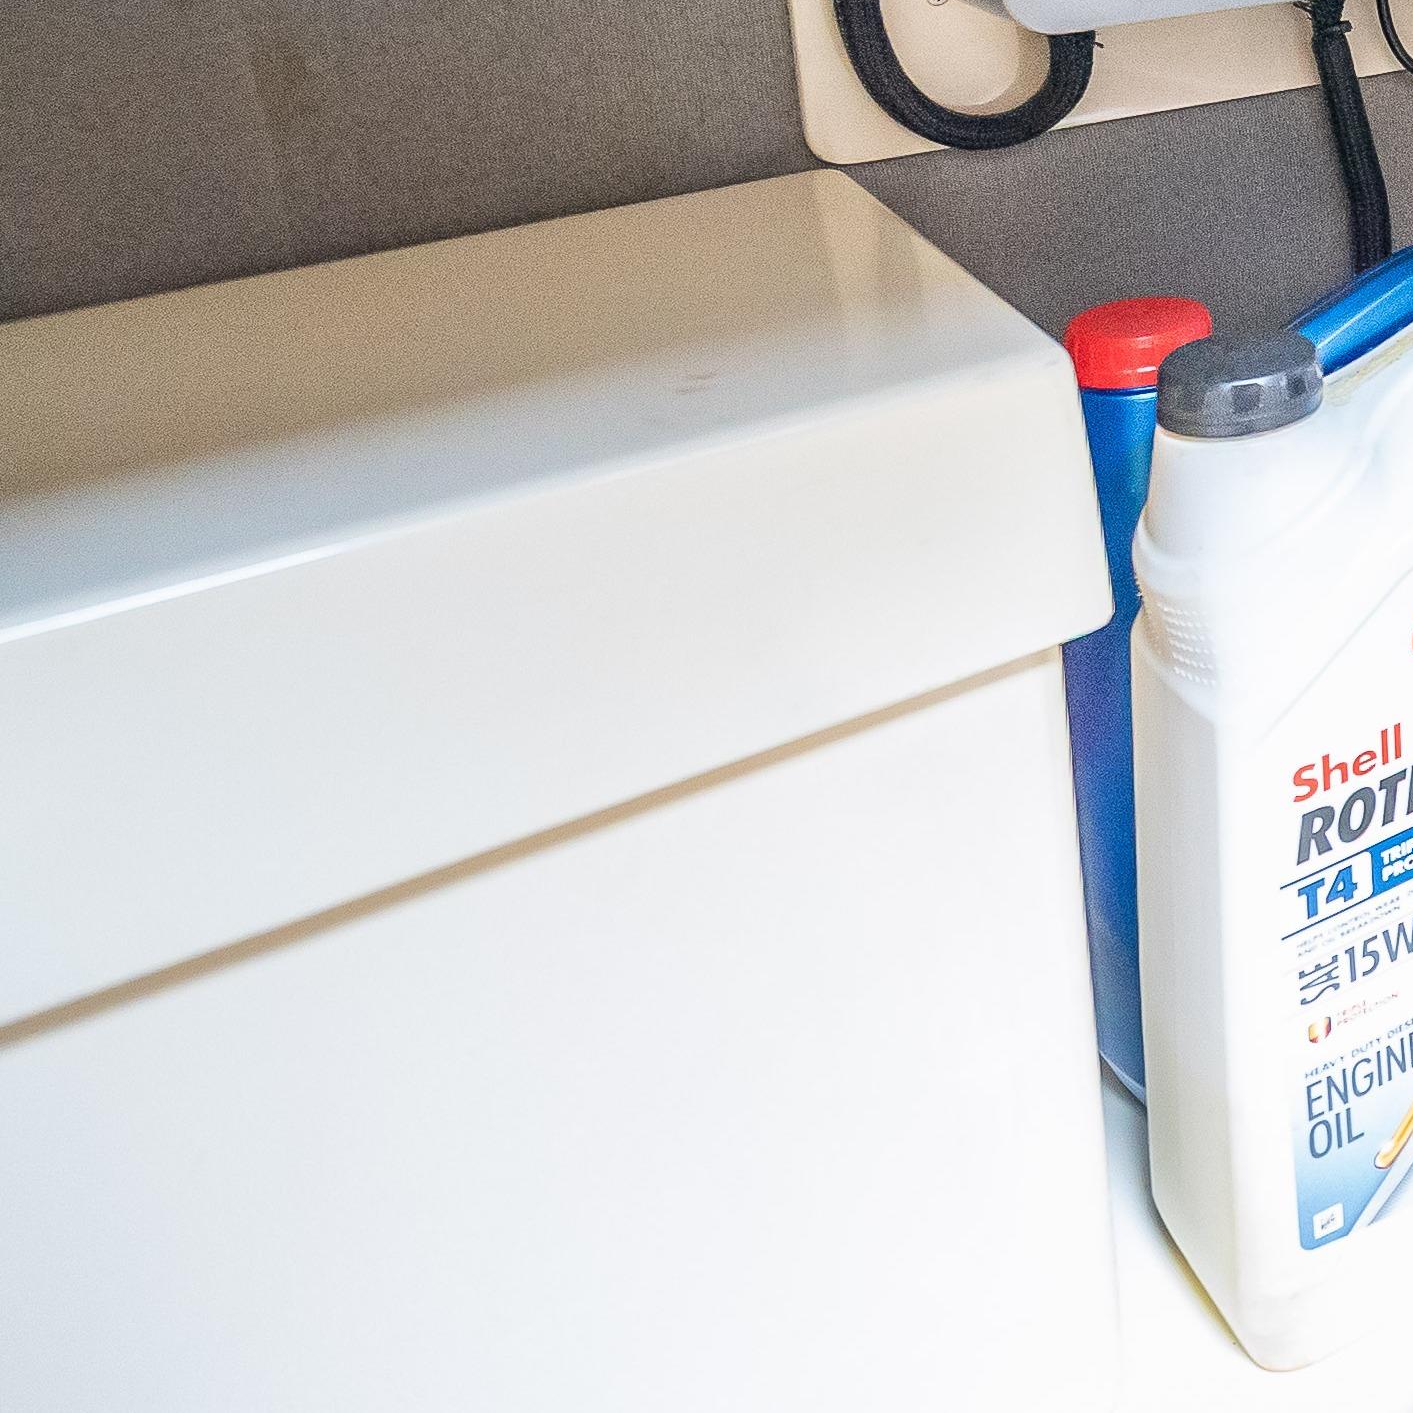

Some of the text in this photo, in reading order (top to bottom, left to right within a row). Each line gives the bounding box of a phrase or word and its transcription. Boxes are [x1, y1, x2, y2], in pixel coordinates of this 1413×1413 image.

[1293, 722, 1401, 802] Shell
[1298, 864, 1359, 920] T4
[1299, 955, 1340, 1005] SAE
[1305, 1056, 1345, 1079] HEAVY
[1351, 1037, 1382, 1058] DUTY
[1308, 1108, 1365, 1159] OIL
